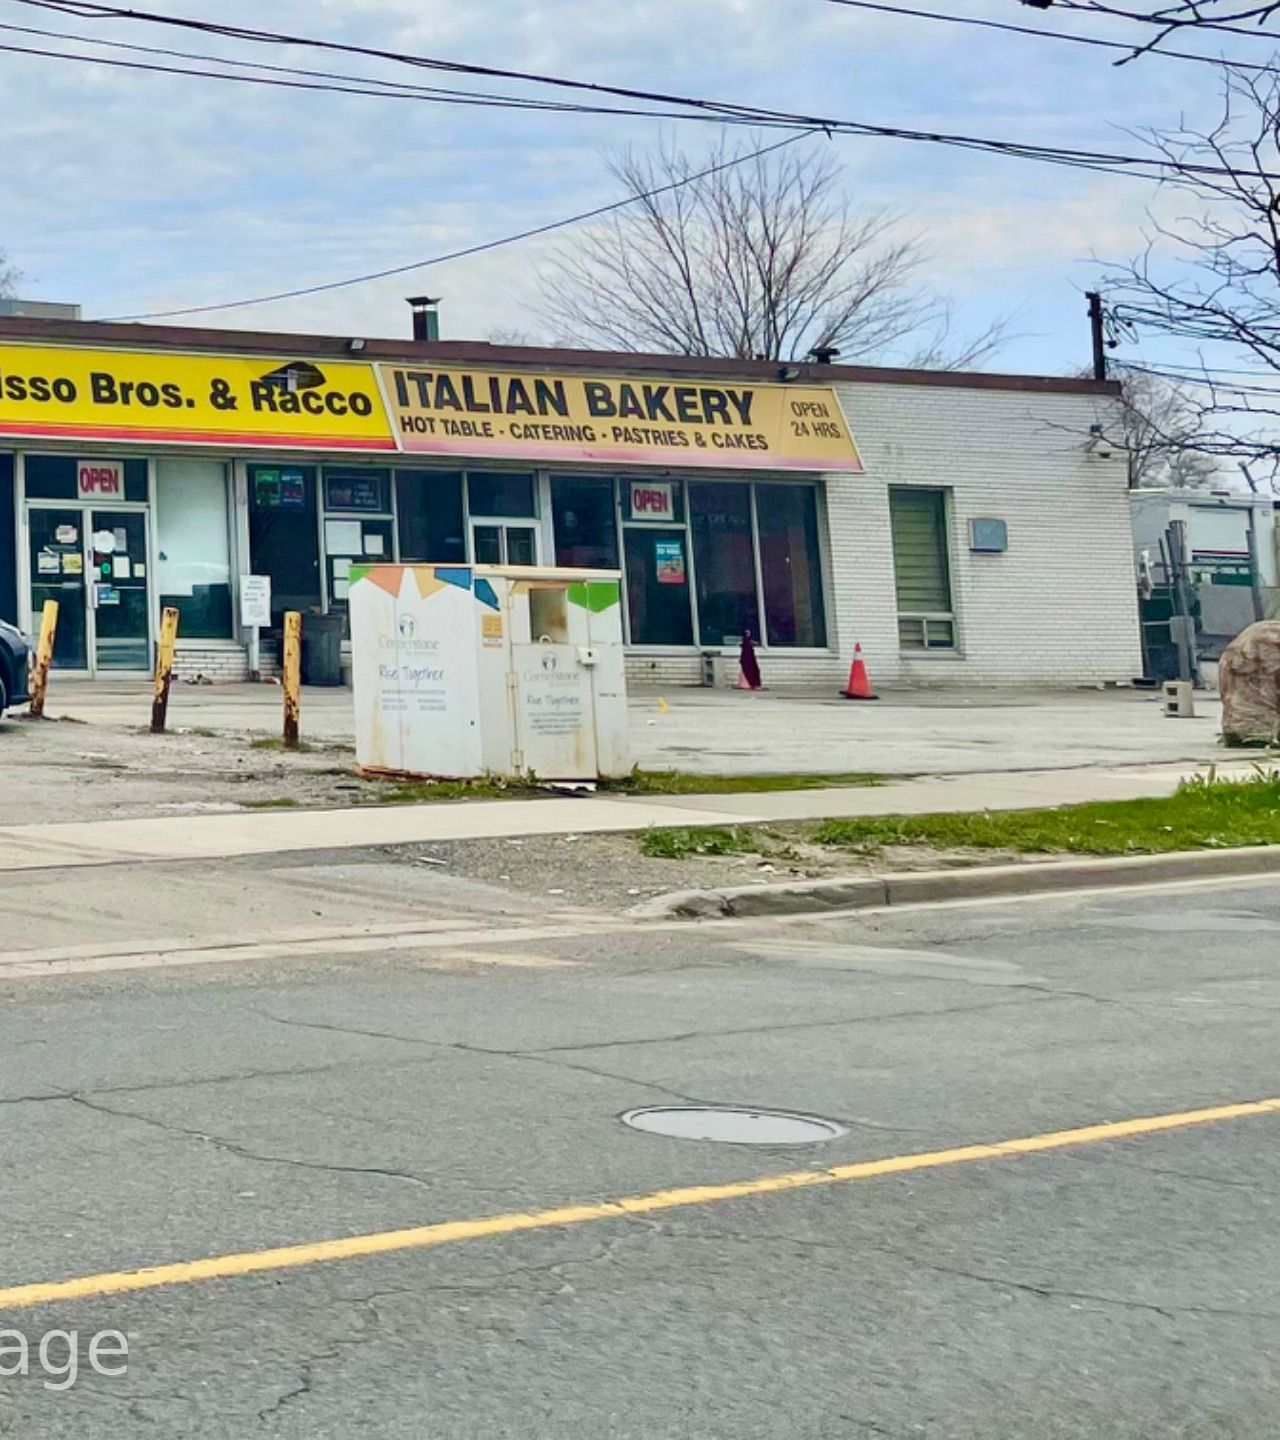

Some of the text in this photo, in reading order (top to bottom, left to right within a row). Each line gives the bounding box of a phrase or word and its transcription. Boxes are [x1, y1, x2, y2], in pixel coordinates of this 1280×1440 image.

[90, 372, 196, 409] Bros.
[210, 378, 239, 411] &
[250, 380, 372, 417] Racco
[394, 371, 754, 425] ITALIAN BAKERY
[791, 401, 830, 418] OPEN
[400, 416, 769, 450] HOT TABLE CATERING PASTRIES & CAKES
[791, 421, 810, 437] 24
[80, 468, 120, 493] OPEN
[634, 489, 669, 513] OPEN
